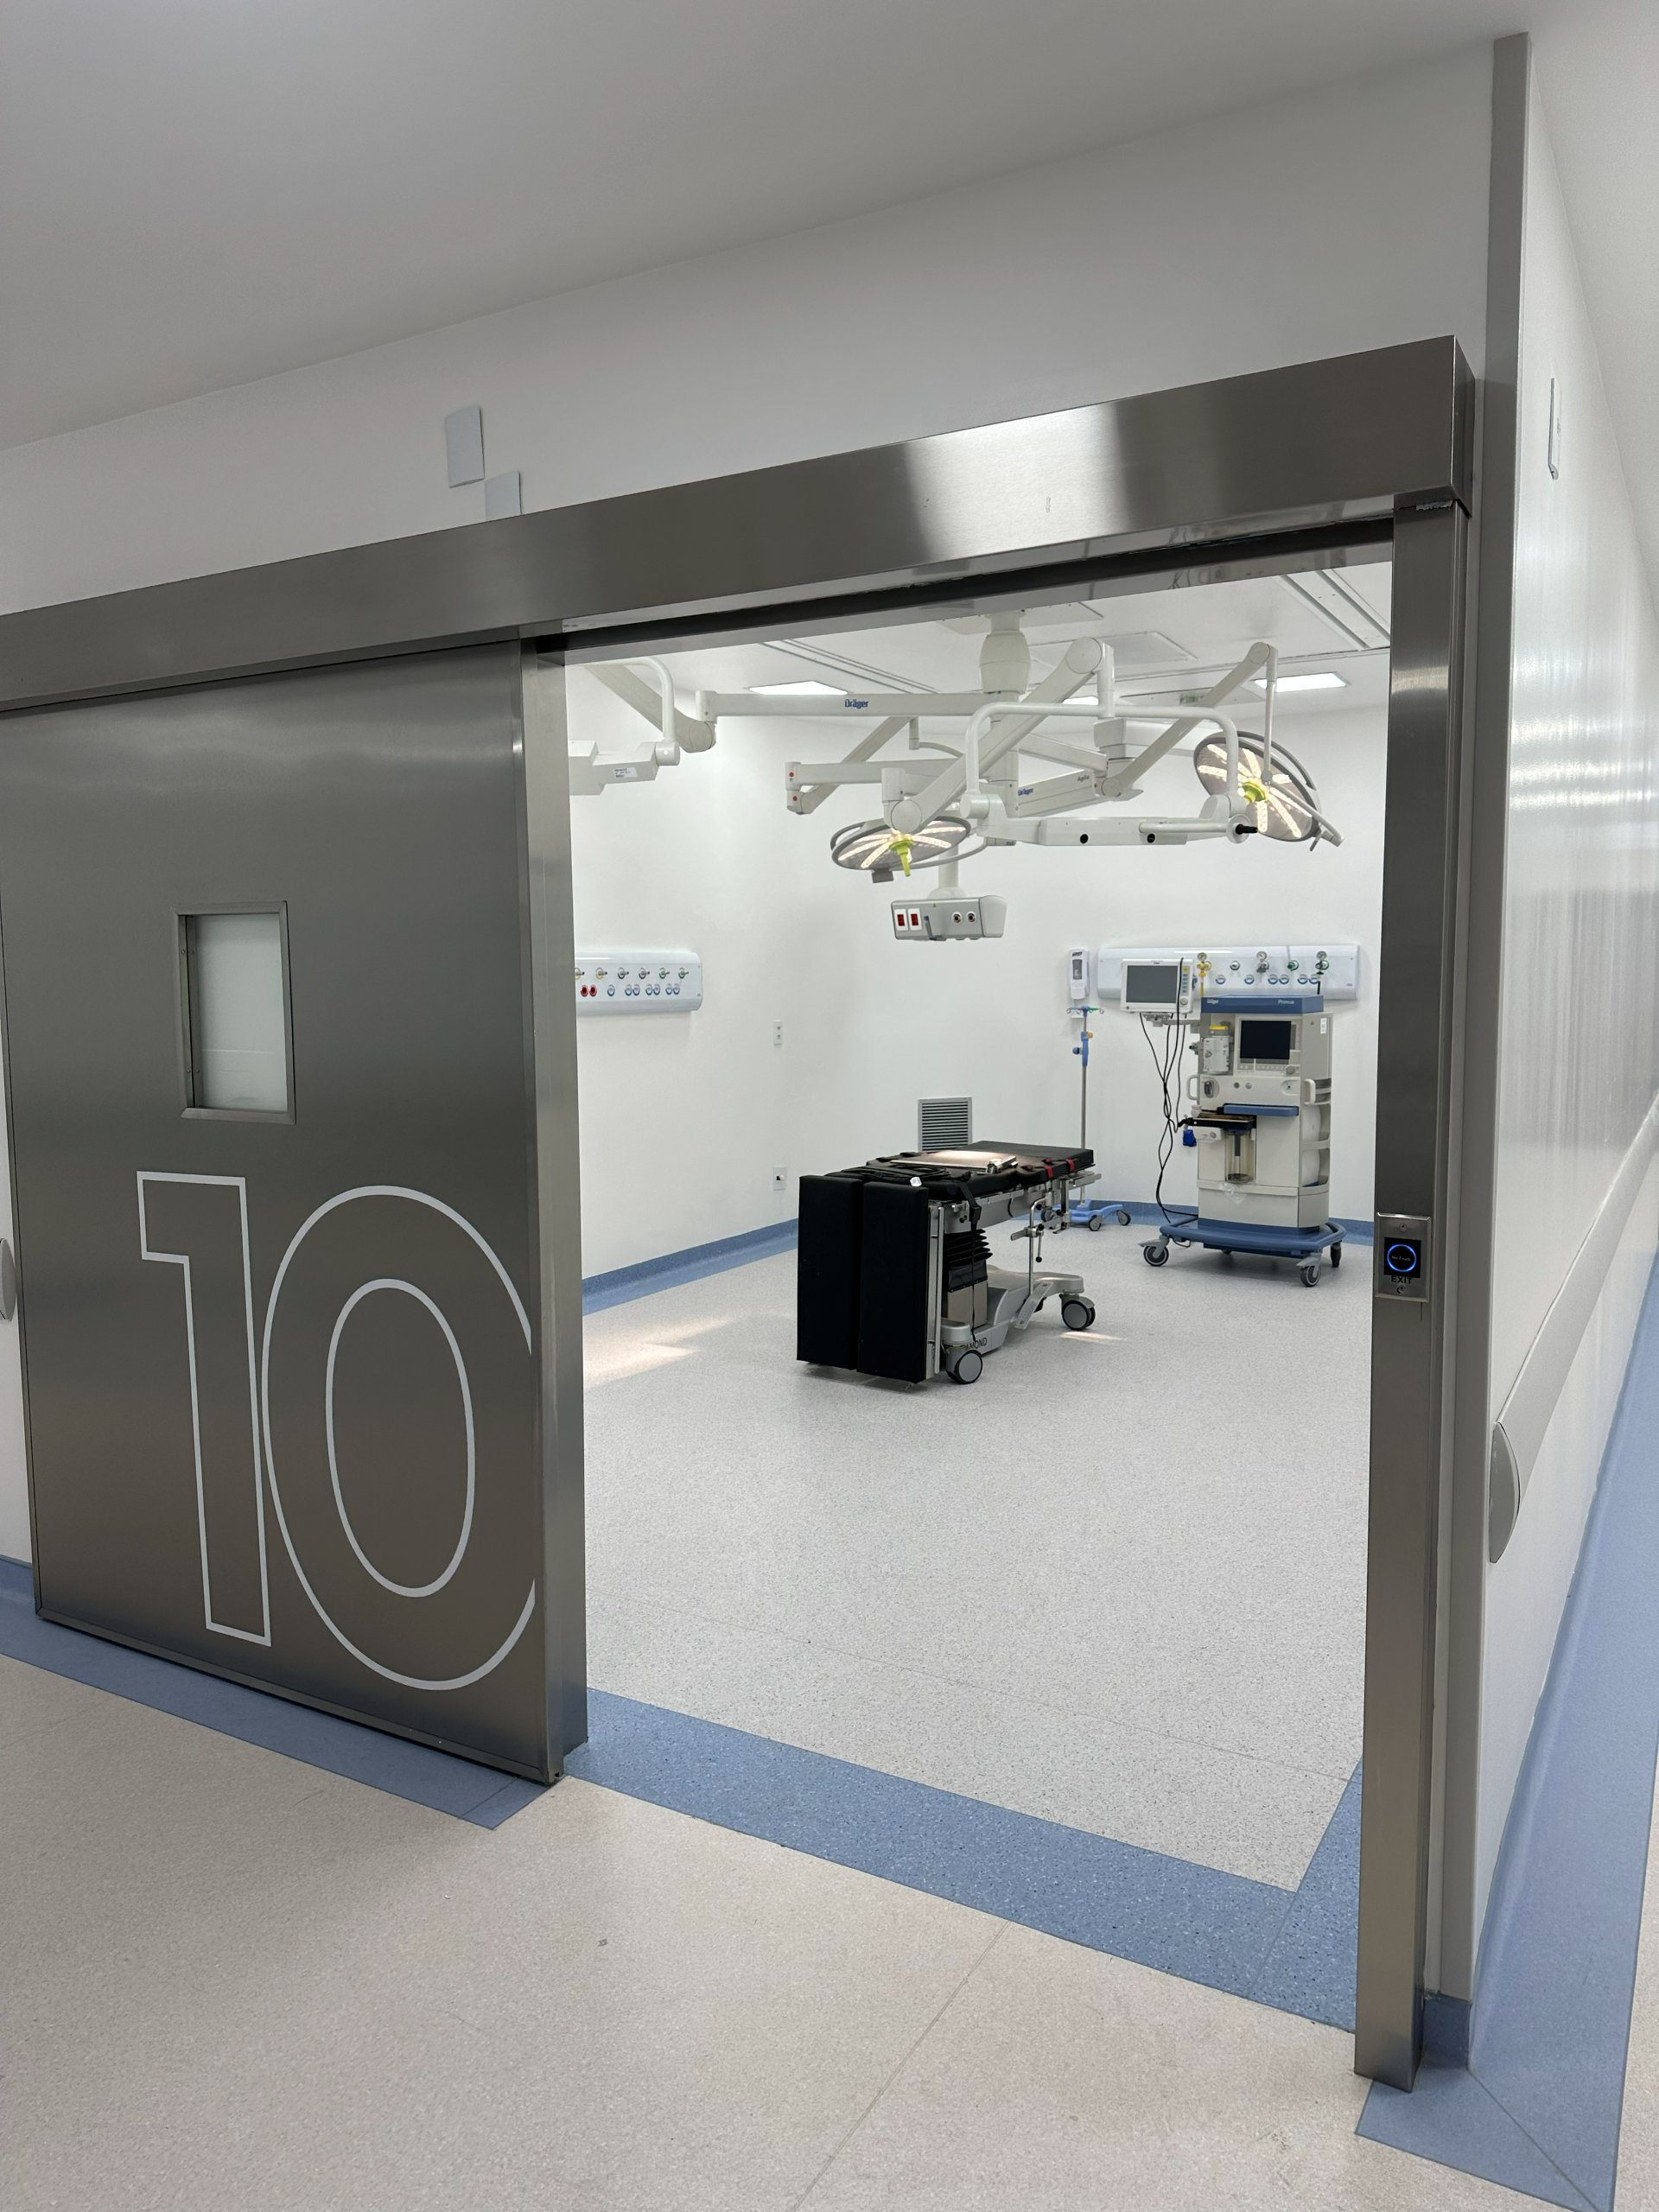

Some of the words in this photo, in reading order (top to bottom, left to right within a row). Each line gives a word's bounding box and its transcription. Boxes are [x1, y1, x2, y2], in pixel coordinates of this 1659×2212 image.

[844, 698, 869, 709] Dräger
[1391, 1275, 1412, 1284] EXIT
[137, 1171, 536, 1691] 10
